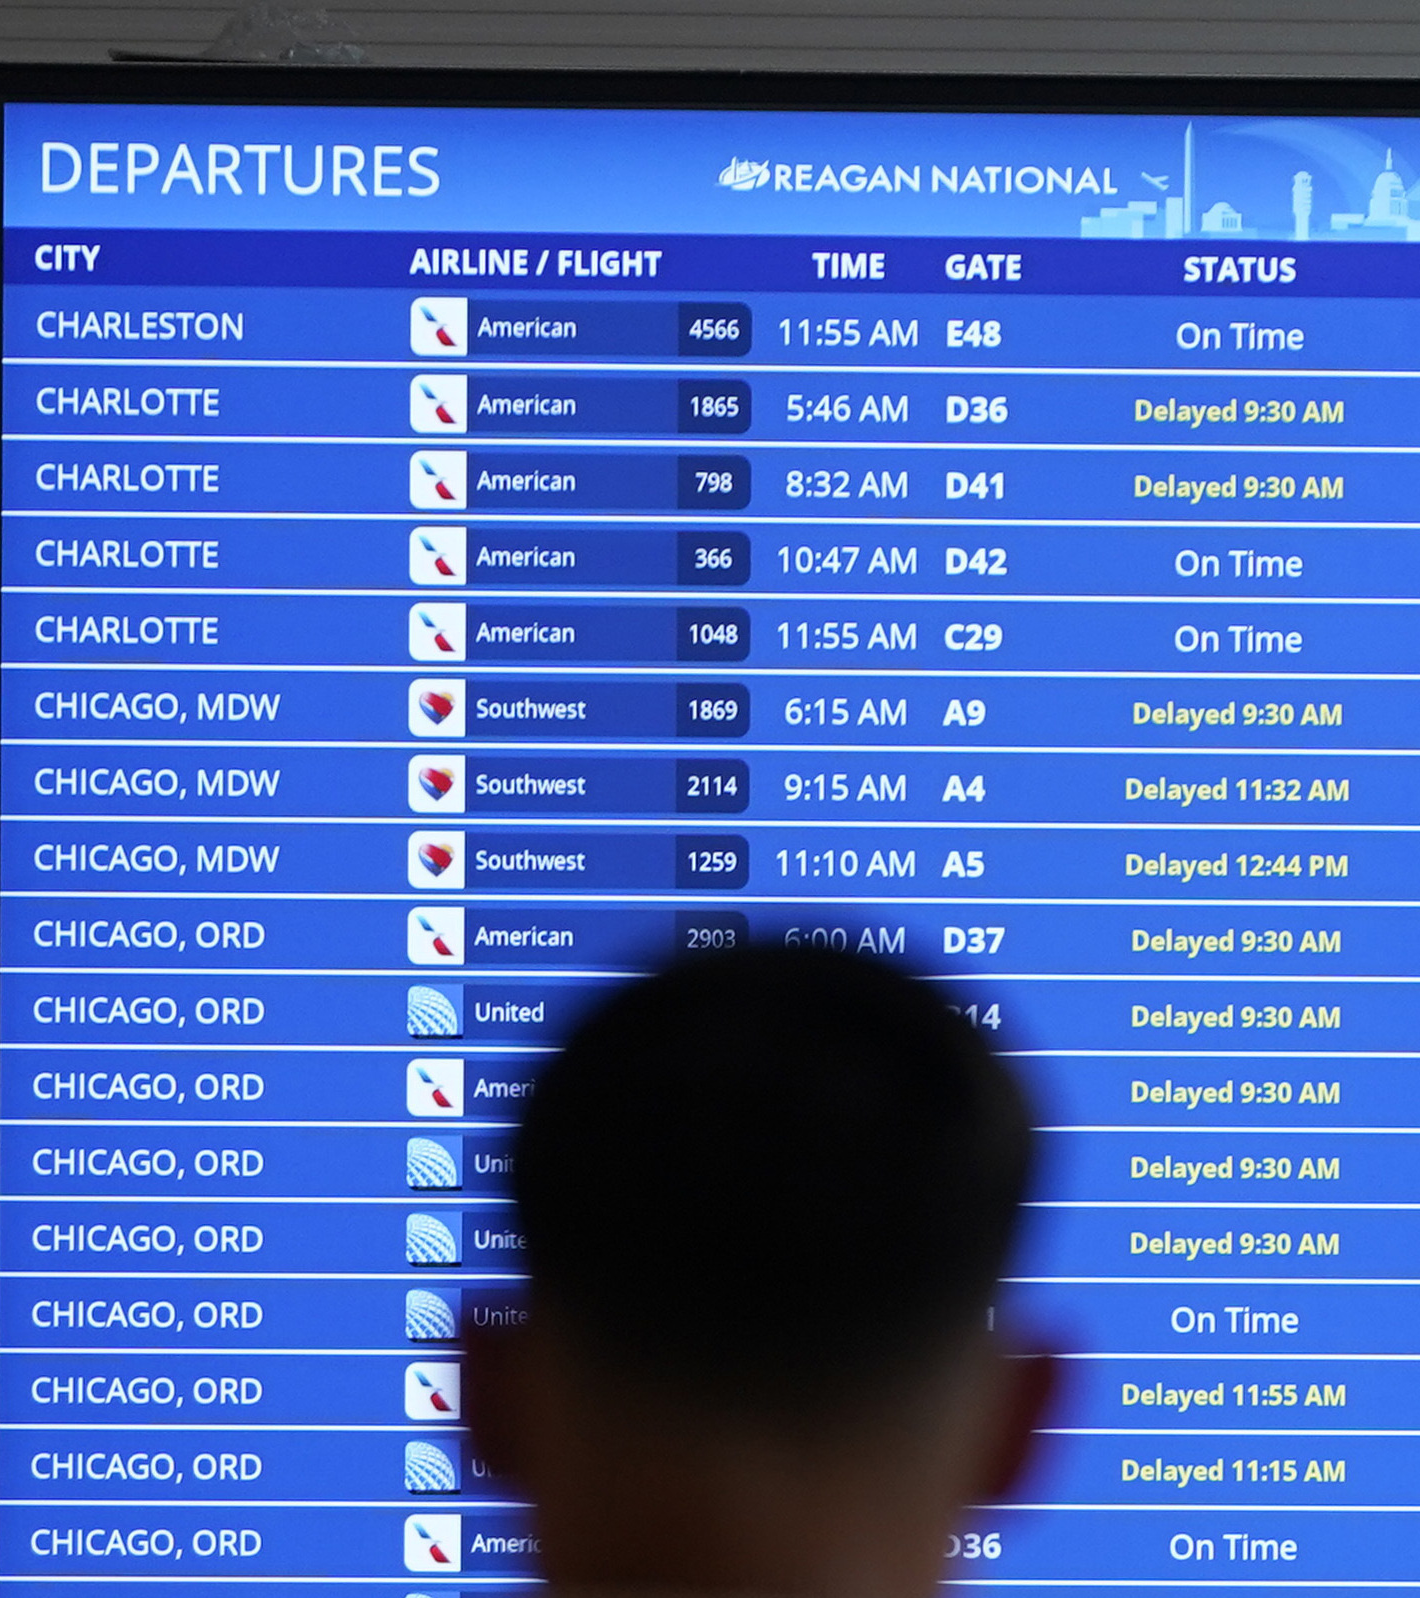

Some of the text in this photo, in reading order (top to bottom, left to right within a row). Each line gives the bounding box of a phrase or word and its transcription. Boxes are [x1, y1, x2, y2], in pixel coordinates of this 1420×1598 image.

[41, 141, 440, 197] DEPARTURES
[774, 163, 1118, 195] REAGAN NATIONAL
[34, 244, 1296, 283] CITY AIRLINE / FLIGHT TIME GATE STATUS
[36, 310, 1305, 351] CHARLESTON American 4566 11:55 AM E48 On Time
[35, 463, 1344, 505] CHARLOTTE American 798 8:32 AM D41 Delayed 9:30 AM
[33, 843, 1349, 883] CHICAGO, MDW Southwest 1259 11:10 AM A5 Delayed 12:44 PM
[33, 996, 1341, 1035] CHICAGO, ORD United 14 Delayed 9:30 AM
